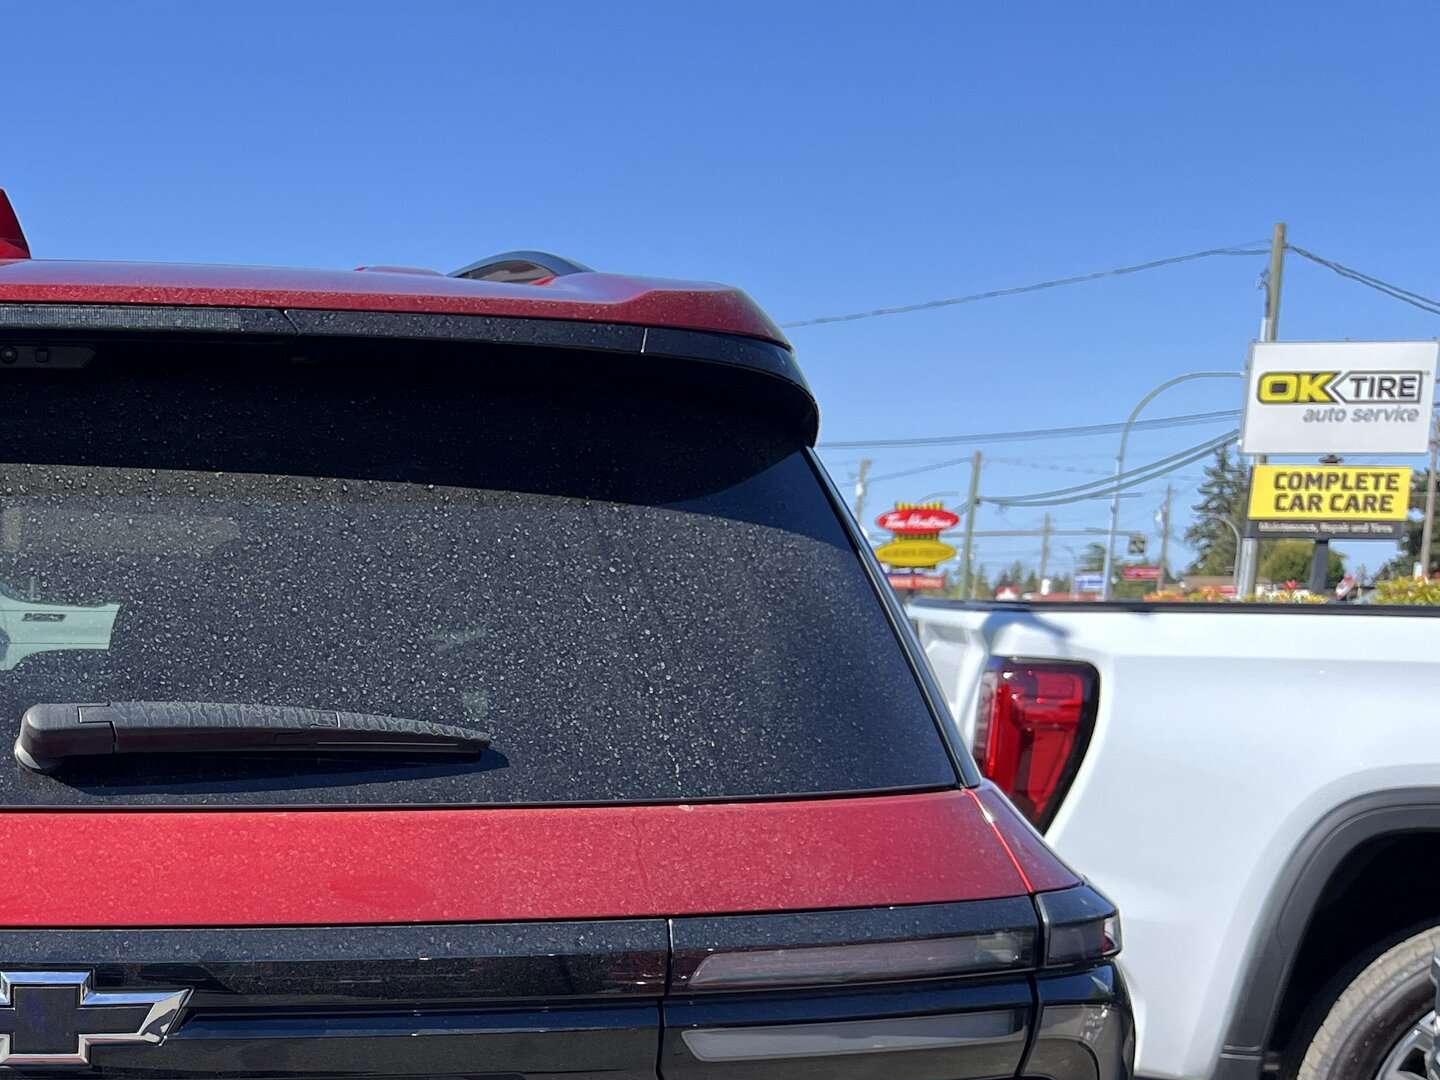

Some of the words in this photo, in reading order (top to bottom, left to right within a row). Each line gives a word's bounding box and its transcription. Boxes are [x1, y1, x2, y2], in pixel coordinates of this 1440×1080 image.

[1257, 371, 1341, 404] OK
[1350, 376, 1418, 398] TIRE
[1303, 407, 1346, 422] auto
[1351, 405, 1420, 422] service
[1274, 472, 1400, 491] COMPLETE
[1274, 493, 1323, 512] CAR
[1329, 493, 1394, 512] CARE
